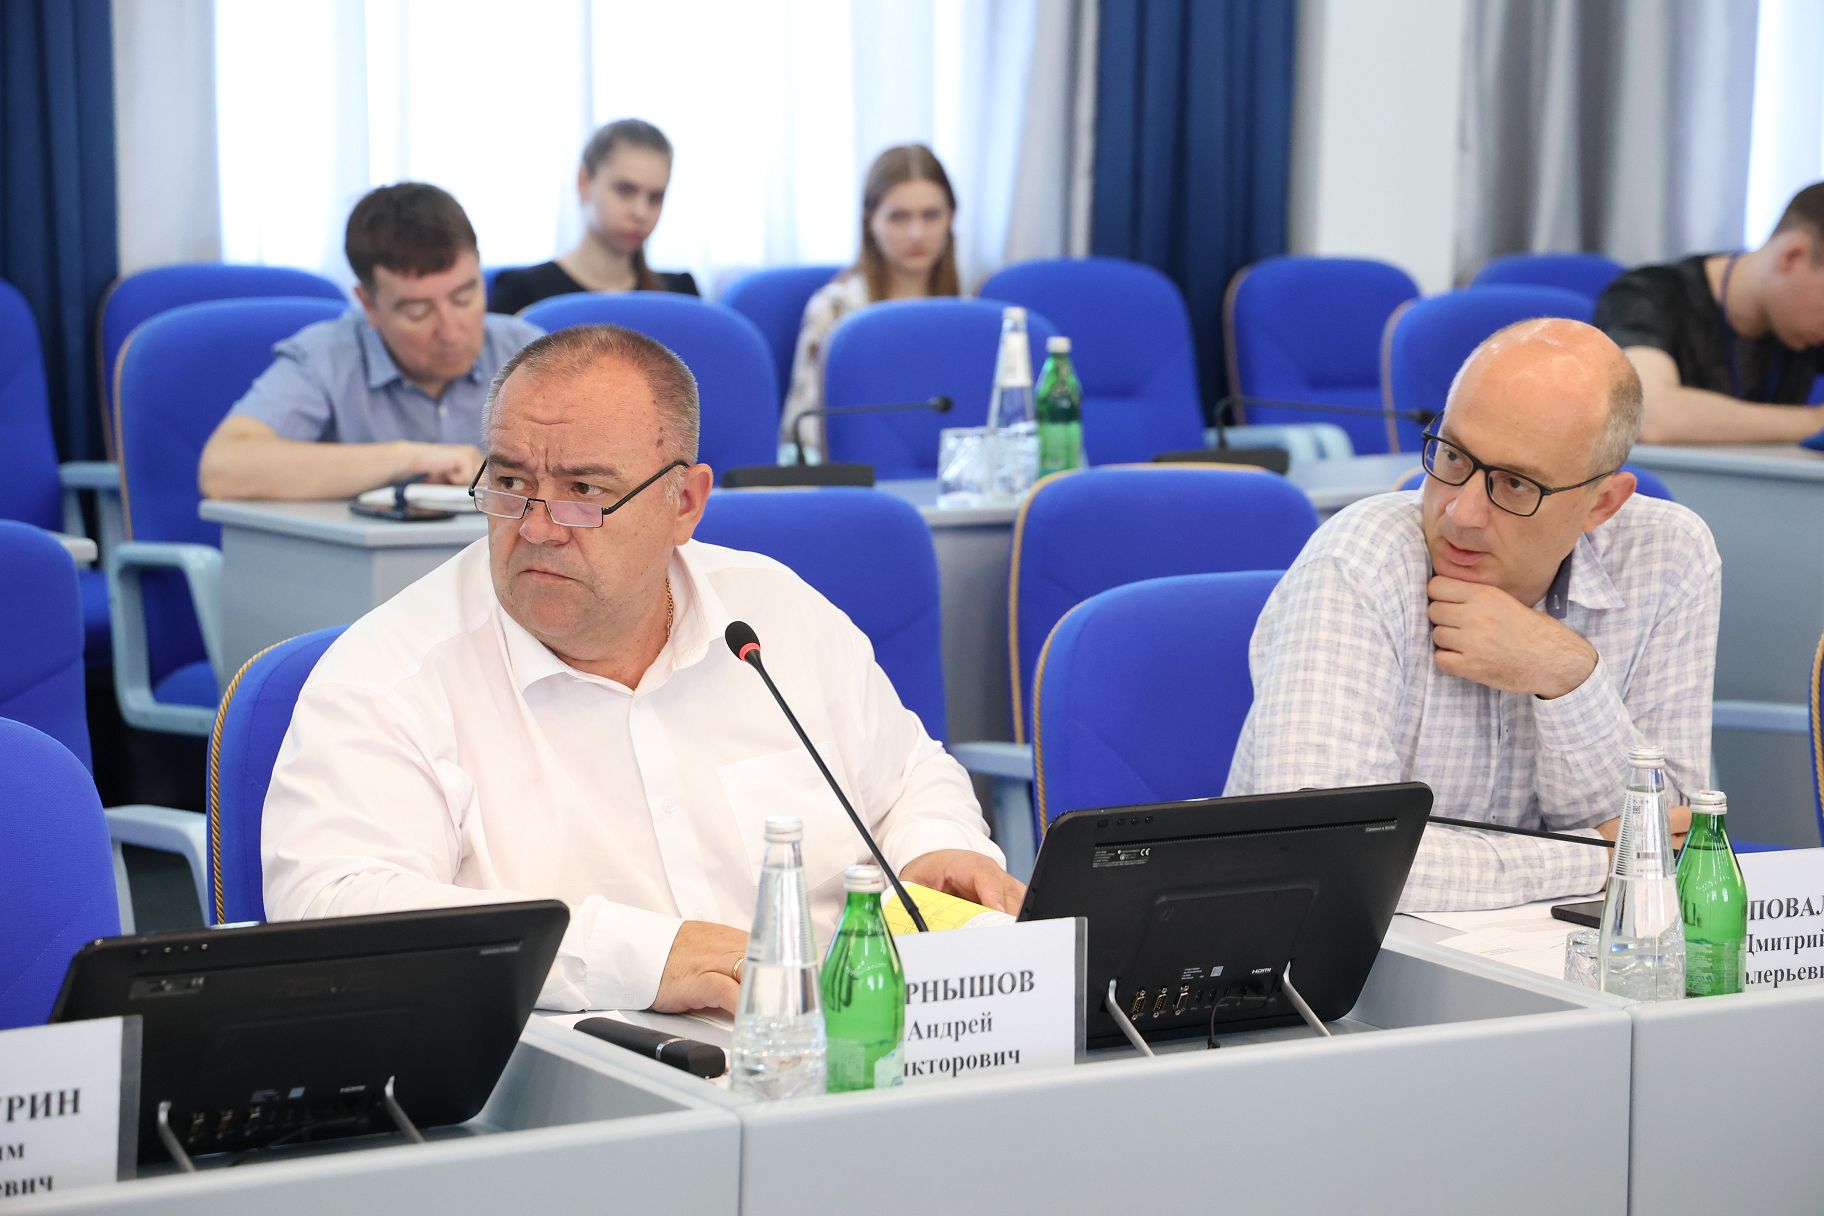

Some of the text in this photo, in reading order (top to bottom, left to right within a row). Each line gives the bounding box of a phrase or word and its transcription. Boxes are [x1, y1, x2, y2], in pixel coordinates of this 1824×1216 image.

[905, 970, 1036, 1004] РНЫШОВ
[1251, 967, 1272, 975] HDMI
[907, 1012, 994, 1042] Андрей
[0, 1087, 81, 1122] РИН
